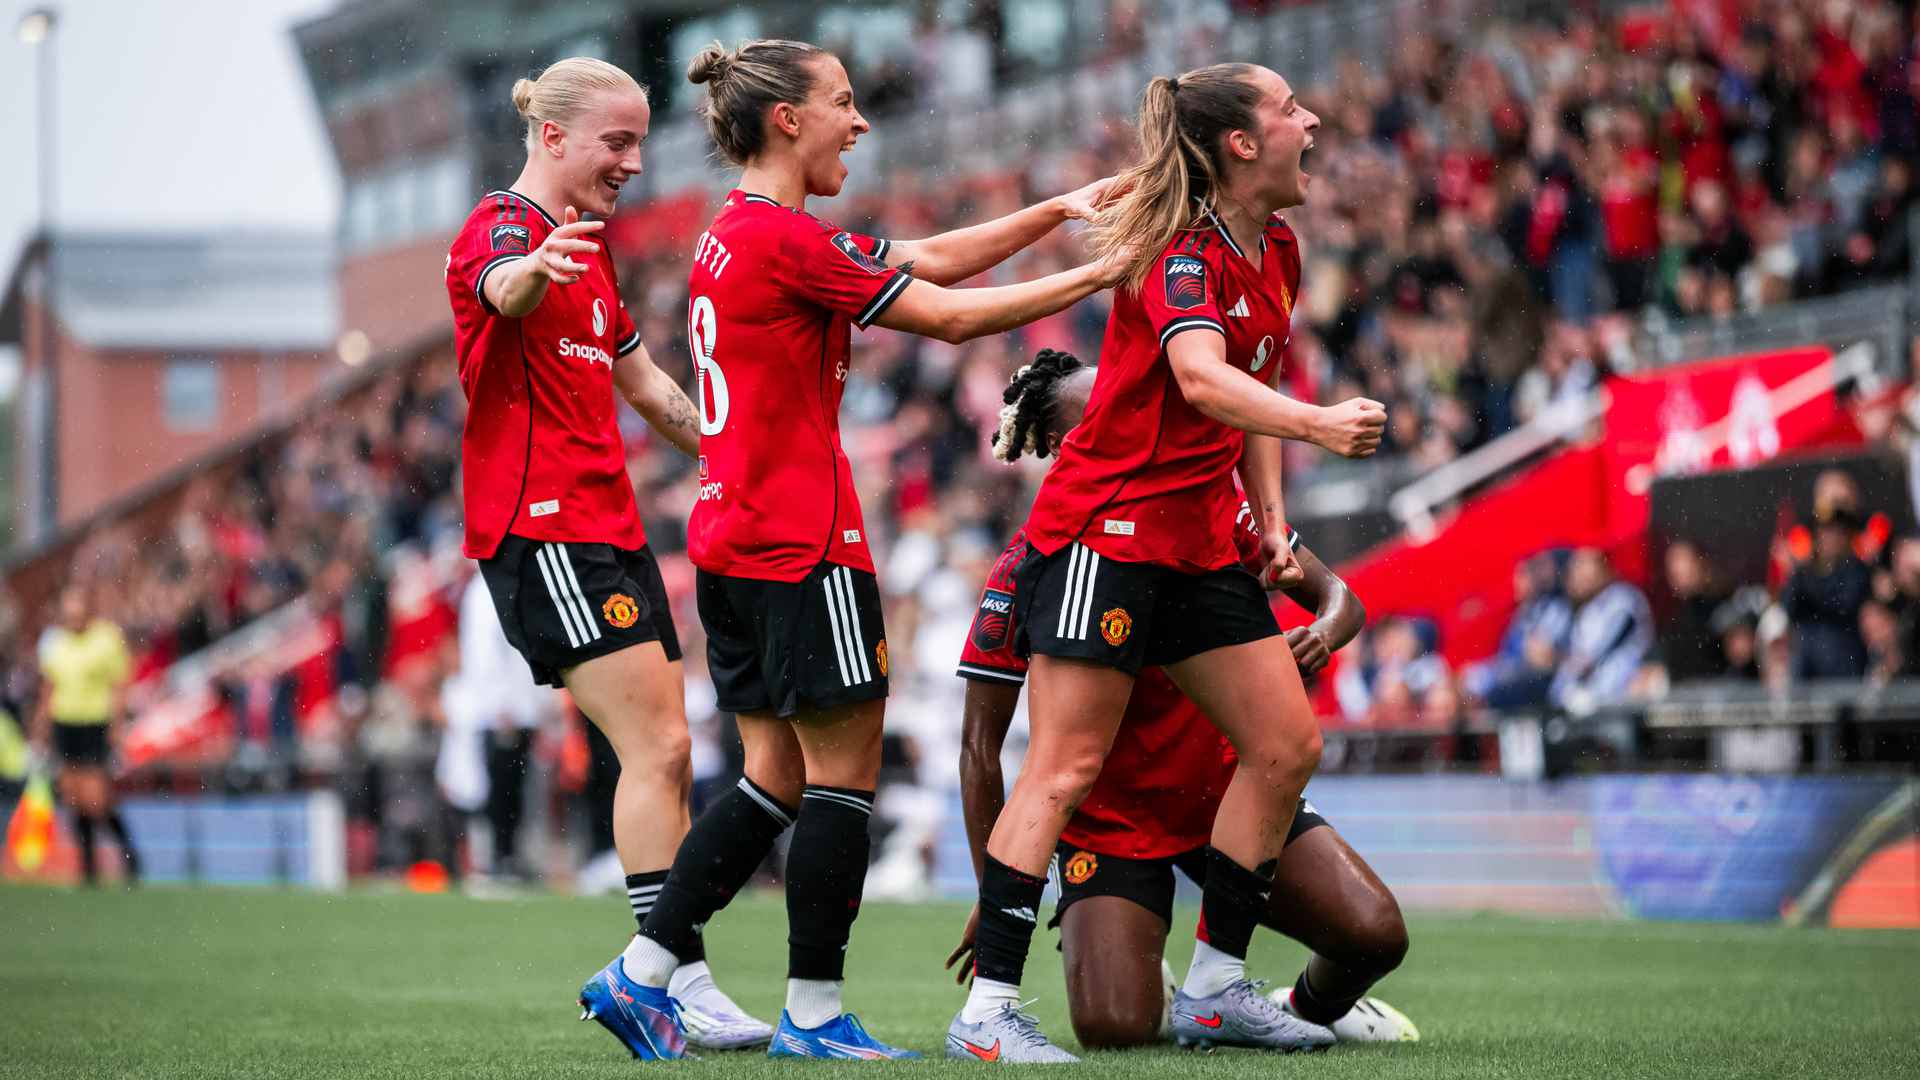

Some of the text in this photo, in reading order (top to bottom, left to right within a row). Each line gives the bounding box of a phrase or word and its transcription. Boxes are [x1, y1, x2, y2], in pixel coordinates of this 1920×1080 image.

[694, 231, 732, 280] OTTI
[1167, 262, 1203, 276] WSL
[688, 295, 730, 436] 8
[980, 597, 1010, 614] WSL
